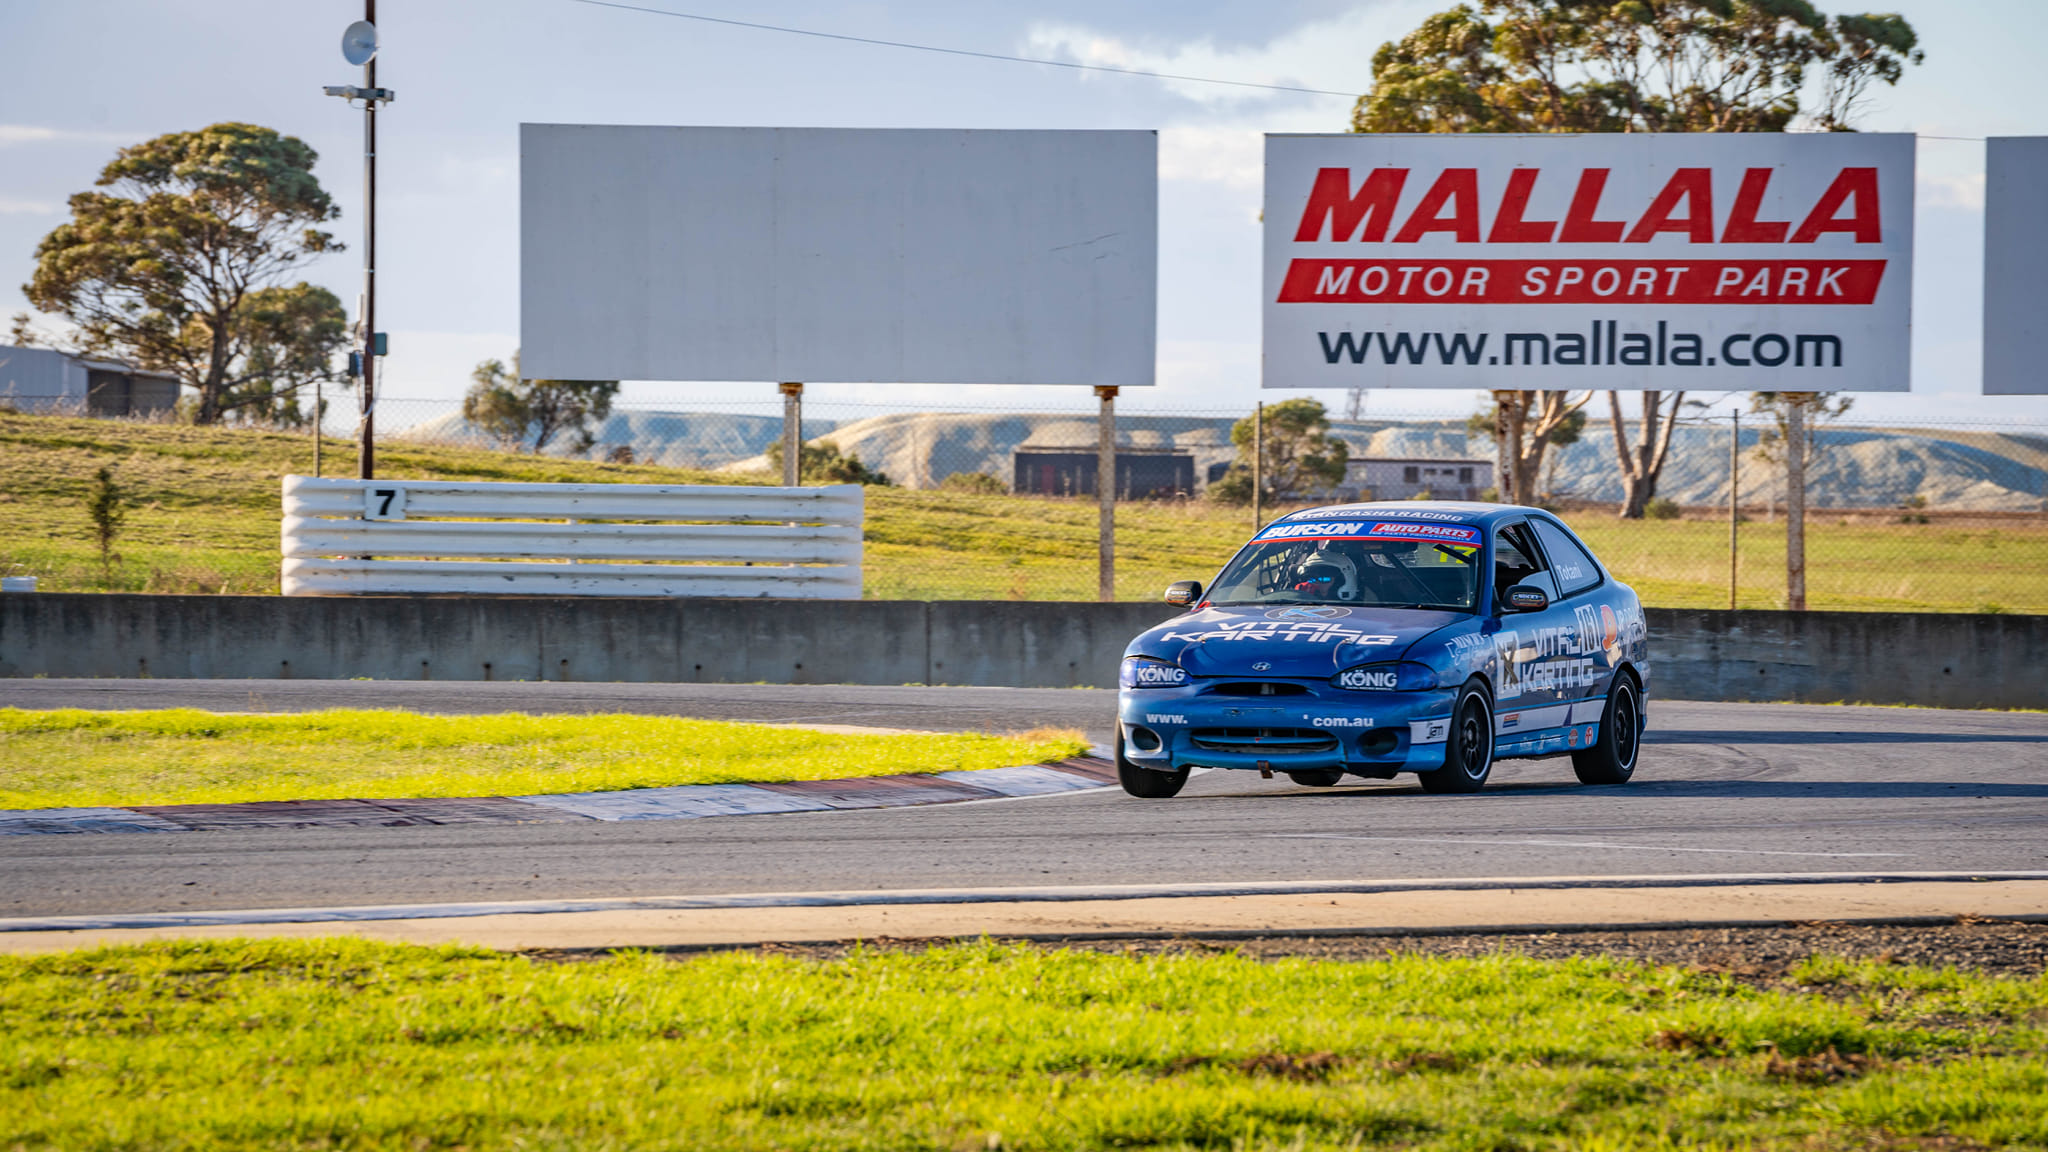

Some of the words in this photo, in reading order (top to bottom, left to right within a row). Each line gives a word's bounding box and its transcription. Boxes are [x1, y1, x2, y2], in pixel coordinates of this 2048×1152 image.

[1293, 167, 1882, 244] MALLALA
[1314, 266, 1491, 297] MOTOR
[1521, 266, 1690, 297] SPORT
[1714, 266, 1851, 297] PARK
[1317, 320, 1843, 368] www.mallala.com
[375, 489, 396, 516] 7
[1261, 523, 1364, 539] BURSON
[1378, 524, 1421, 534] AUTO
[1420, 526, 1470, 537] PARTS
[1556, 562, 1583, 581] Totani
[1218, 622, 1363, 633] VITAL
[1160, 630, 1398, 645] KARTING
[1532, 627, 1580, 657] VITAL
[1137, 665, 1186, 682] KÖNIG
[1340, 669, 1398, 687] KÖNIG
[1522, 658, 1594, 692] KARTING
[1146, 713, 1188, 725] www.
